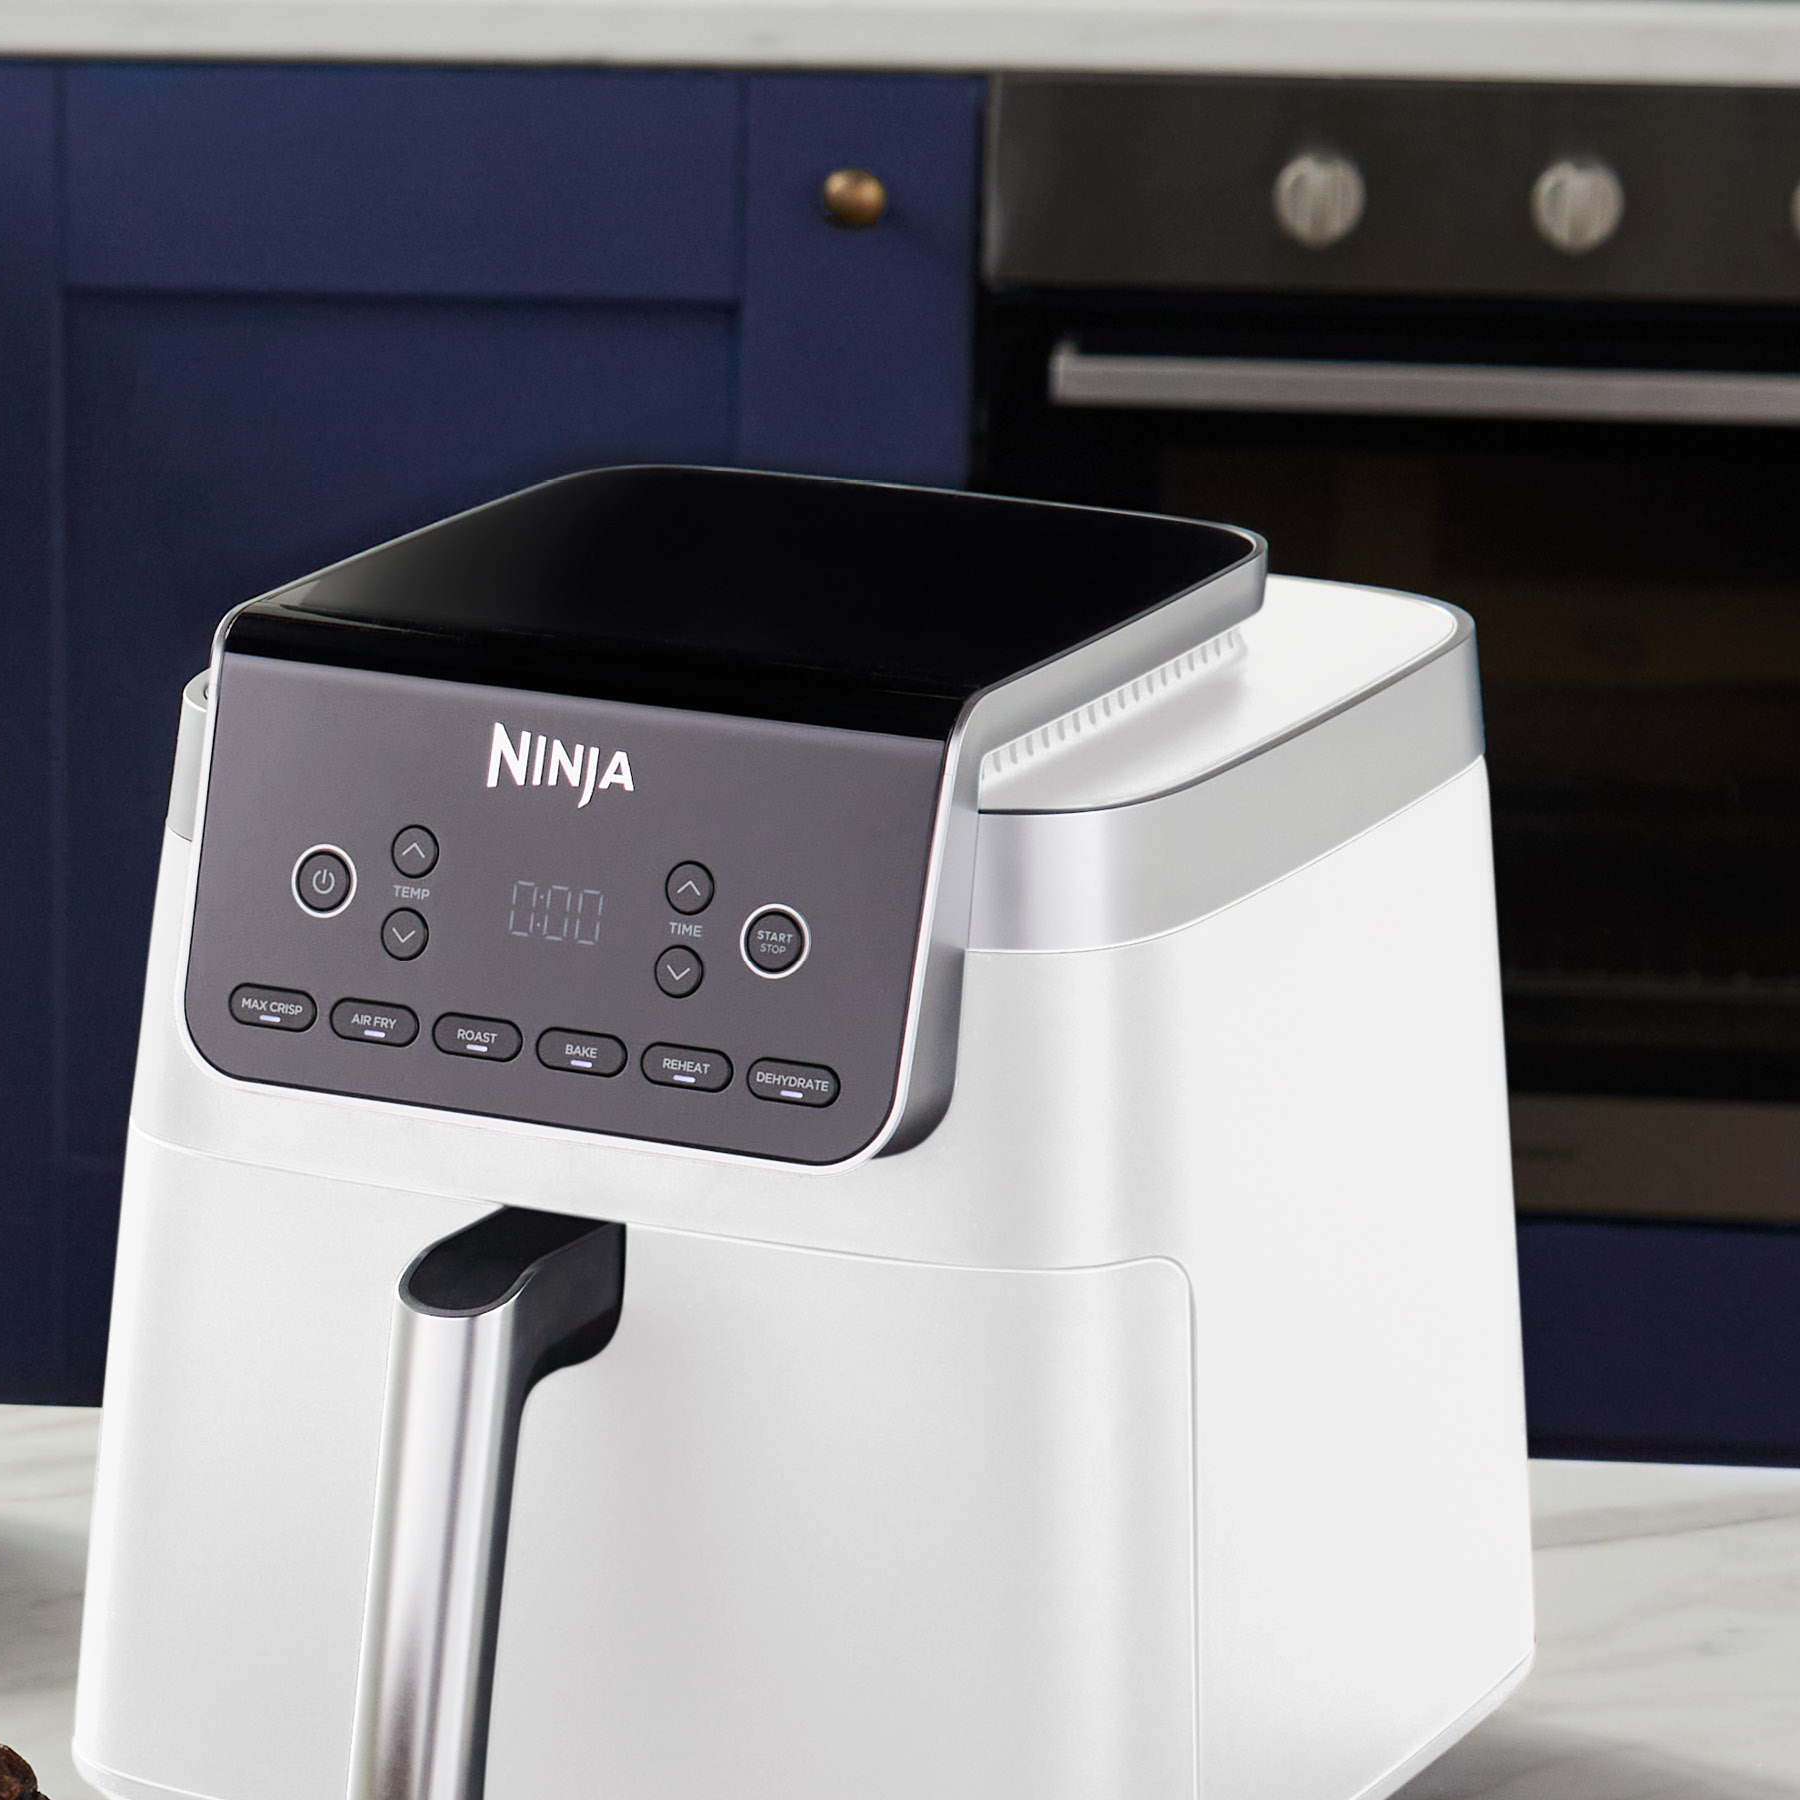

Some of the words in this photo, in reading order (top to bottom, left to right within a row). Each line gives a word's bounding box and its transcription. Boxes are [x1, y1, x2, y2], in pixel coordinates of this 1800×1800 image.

[486, 722, 635, 808] NINJA
[392, 884, 431, 900] TEMP
[669, 921, 703, 938] TIME
[756, 930, 793, 944] START
[760, 943, 786, 954] STOP
[241, 997, 268, 1011] MAX
[269, 1001, 303, 1015] CRISP
[351, 1013, 372, 1026] AIR
[373, 1017, 397, 1030] FRY
[457, 1028, 498, 1044] ROAST
[565, 1043, 598, 1059] BAKE
[662, 1057, 711, 1074] REHEAT
[756, 1071, 830, 1092] DEHYDRATE
